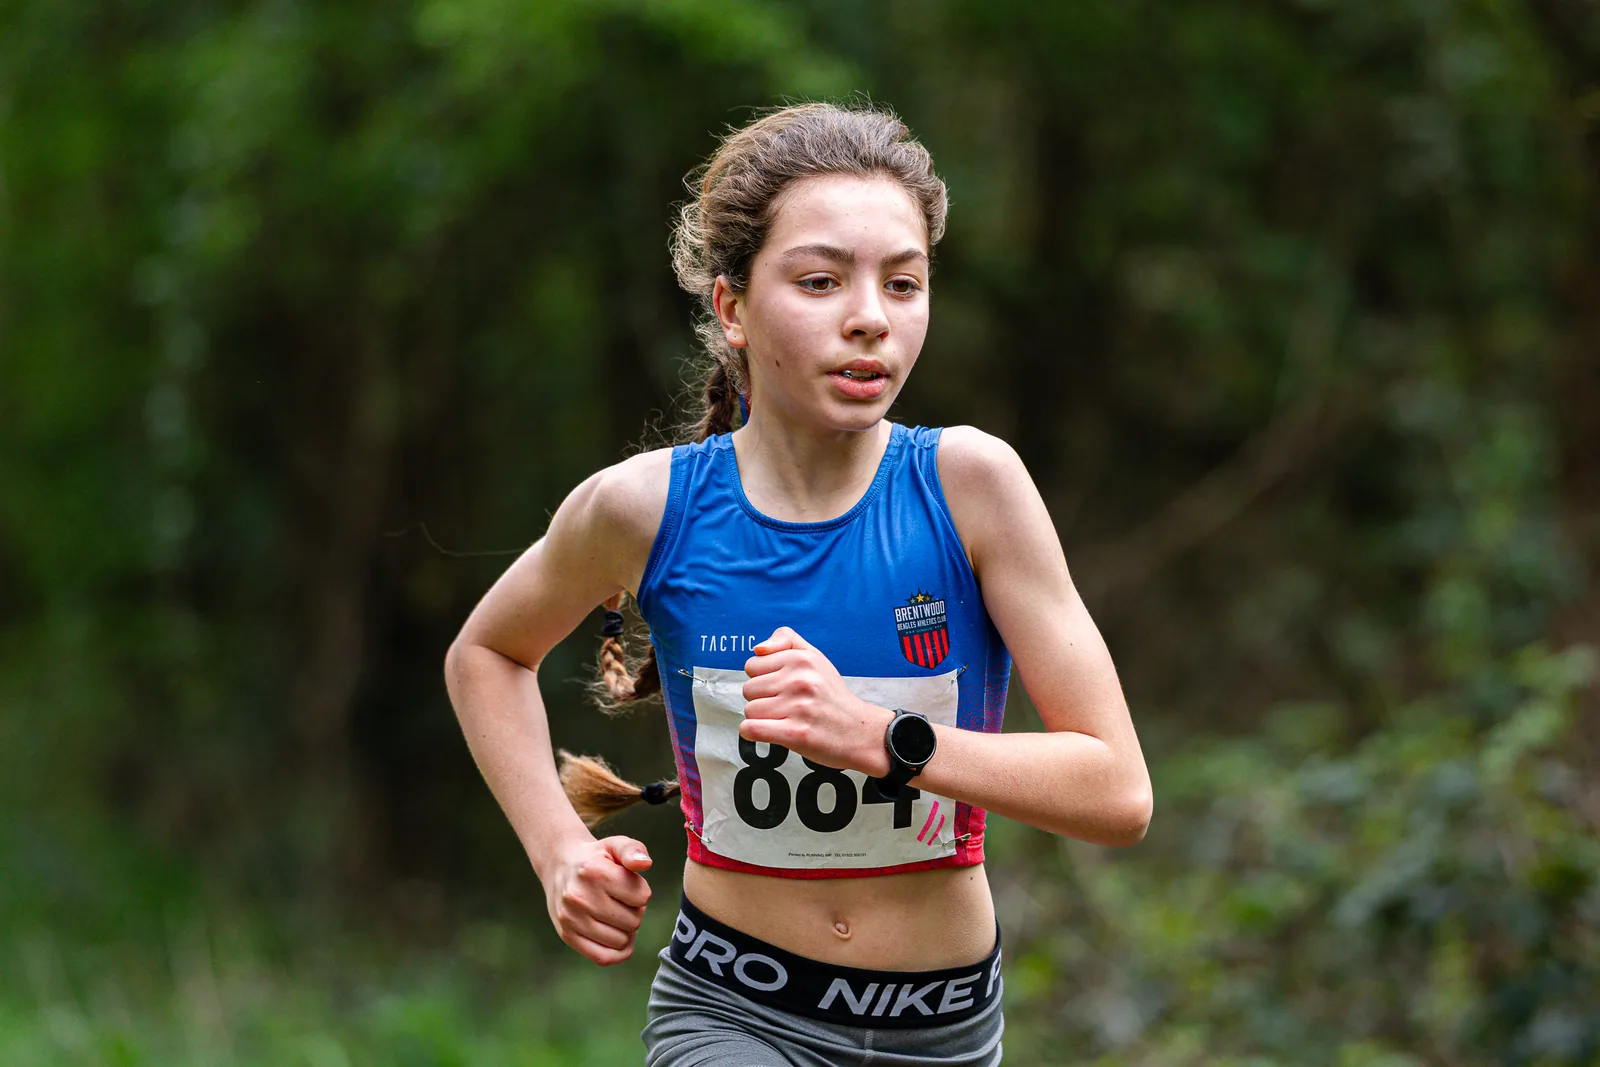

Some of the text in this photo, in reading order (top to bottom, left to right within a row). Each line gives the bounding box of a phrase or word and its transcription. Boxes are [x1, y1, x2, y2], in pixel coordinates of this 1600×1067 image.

[894, 600, 946, 622] BRENTWOOD
[896, 621, 917, 631] BEAGLES
[917, 617, 937, 628] ATHLETICS
[937, 615, 947, 624] CLUB
[700, 635, 756, 652] TACTIC
[672, 909, 788, 991] PRO
[817, 971, 983, 1017] NIKE
